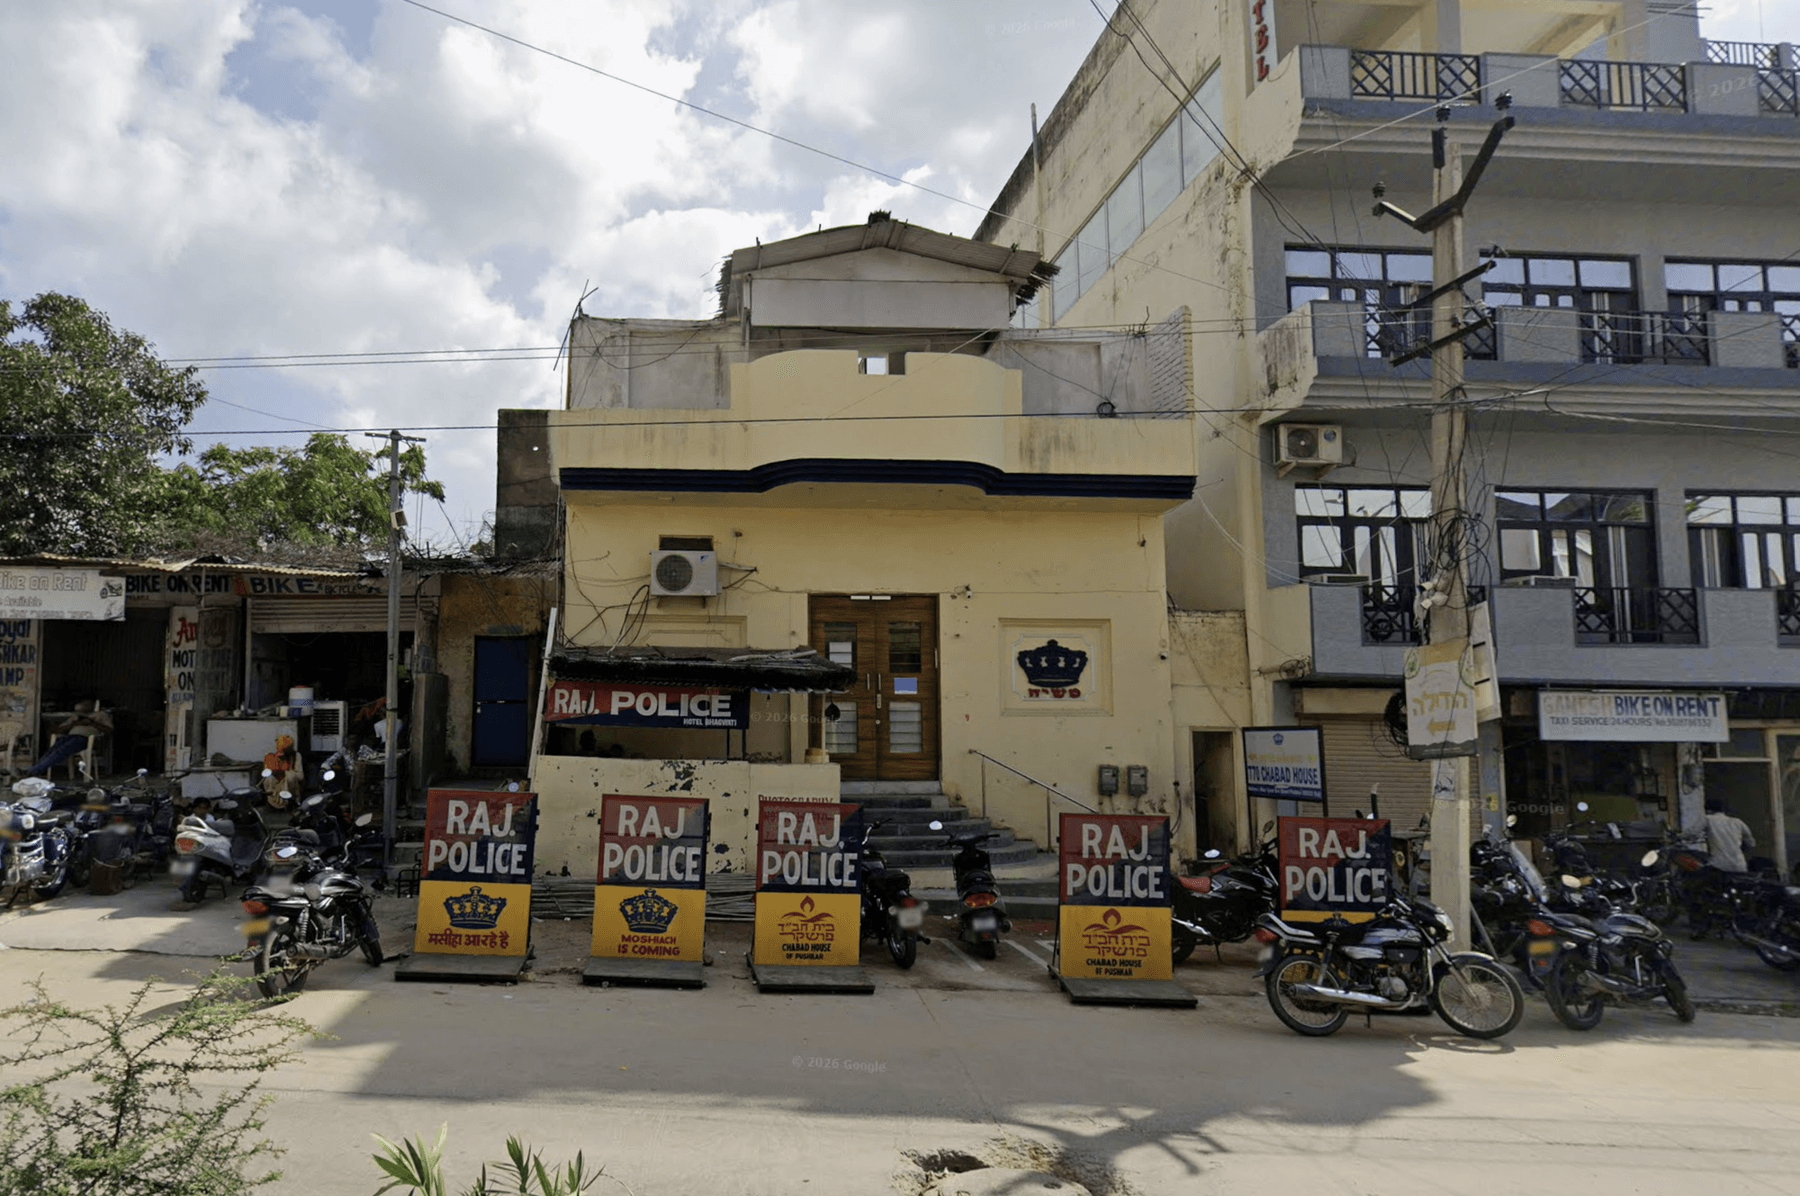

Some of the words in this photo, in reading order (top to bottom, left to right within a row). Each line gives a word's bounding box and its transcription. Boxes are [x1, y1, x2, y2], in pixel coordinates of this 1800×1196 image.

[30, 575, 48, 590] on
[52, 572, 87, 591] Rent
[126, 575, 160, 592] BIKE
[250, 577, 319, 593] BIKE
[610, 690, 732, 718] POLICE
[1614, 696, 1651, 716] BIKE
[1653, 696, 1673, 716] ON
[1676, 697, 1720, 718] RENT
[683, 718, 703, 726] HOTEL
[1550, 717, 1569, 726] TAXI
[1572, 717, 1608, 726] SERVICE
[1248, 765, 1261, 781] 770
[1261, 766, 1291, 783] CHABAD
[1292, 767, 1318, 785] HOUSE
[446, 799, 516, 838] RAJ.
[617, 804, 686, 840] RAJ
[1082, 823, 1153, 862] RAJ.
[1298, 827, 1372, 860] RAJ.
[427, 839, 527, 875] POLICE
[603, 842, 701, 882] POLICE
[761, 850, 858, 887] POLICE
[1066, 863, 1164, 899] POLICE
[1285, 865, 1387, 903] POLICE
[618, 944, 628, 954] IS
[632, 944, 681, 957] COMING
[621, 934, 677, 945] MOSHIACH
[782, 943, 810, 952] CHABAD
[811, 943, 832, 952] HOUSE
[1086, 958, 1118, 967] CHABAD
[1119, 958, 1142, 968] HOUSE
